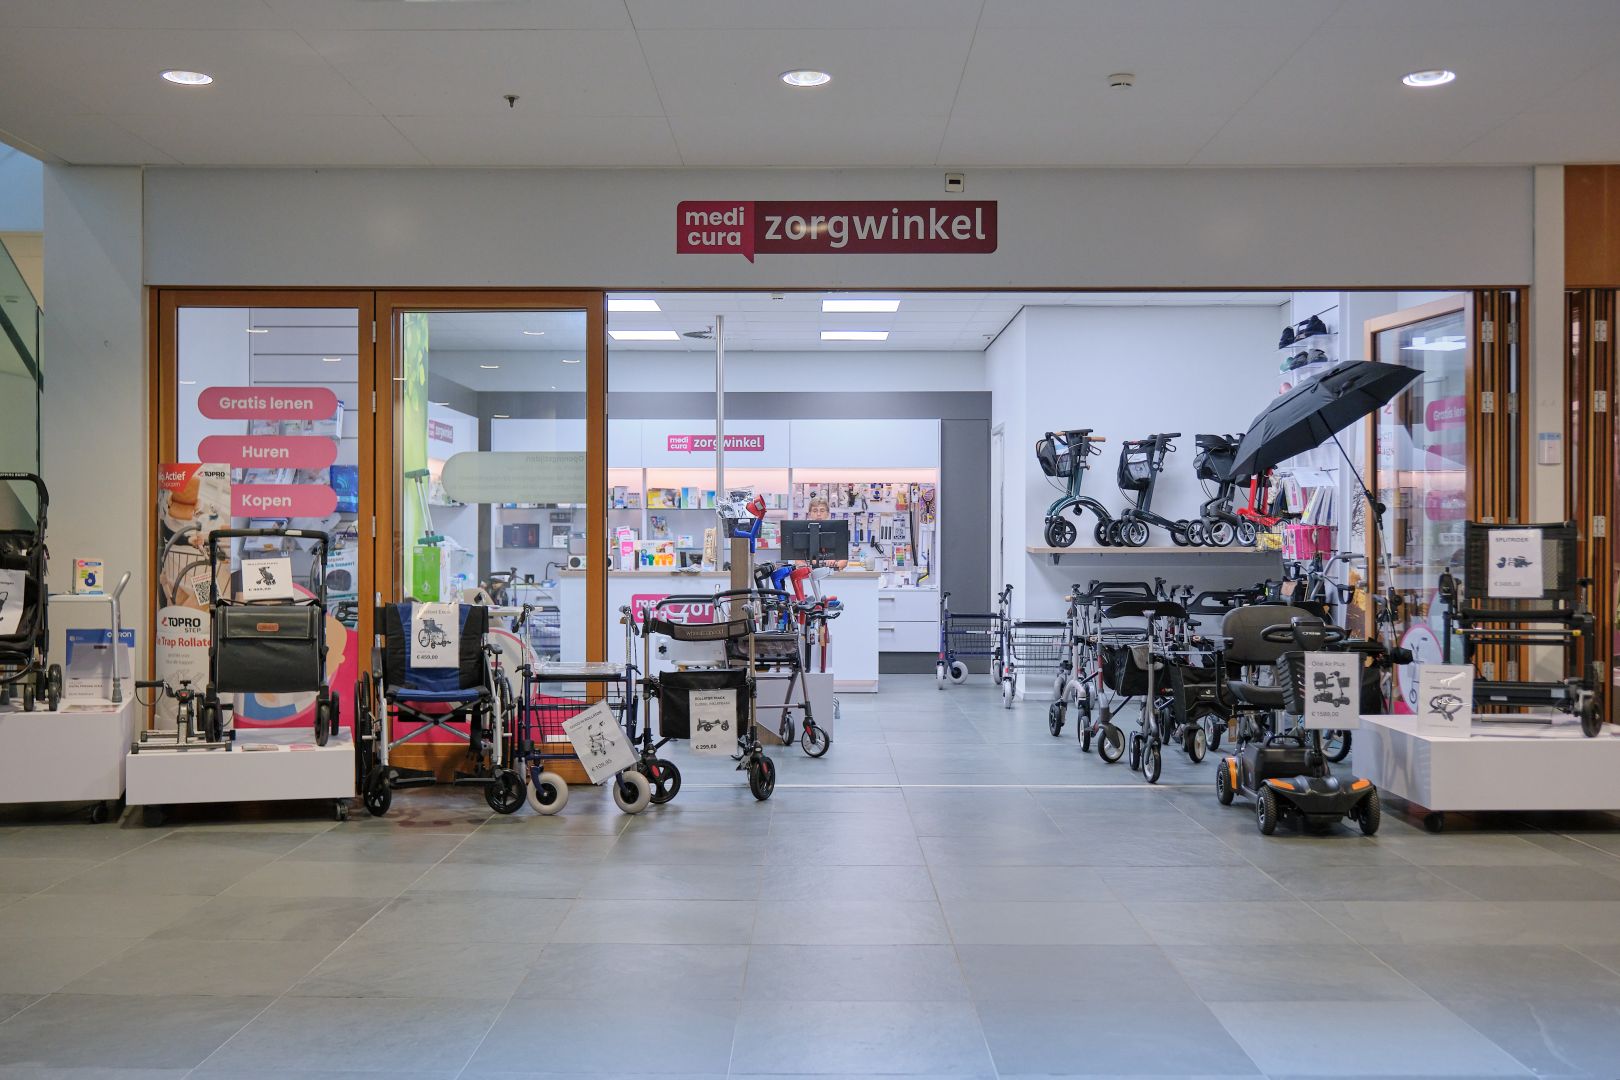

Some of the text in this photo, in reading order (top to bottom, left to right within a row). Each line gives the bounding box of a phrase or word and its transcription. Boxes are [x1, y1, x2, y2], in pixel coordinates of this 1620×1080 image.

[685, 207, 745, 226] medi
[764, 208, 986, 248] zorgwinkel
[687, 229, 741, 246] cura
[219, 396, 313, 410] Gratis lenen
[670, 436, 689, 444] medi
[242, 446, 289, 458] Huren
[165, 471, 186, 481] Actief
[242, 494, 292, 511] Kopen
[168, 617, 201, 628] TOPRO
[162, 636, 176, 648] Trap
[178, 637, 212, 647] Rollato
